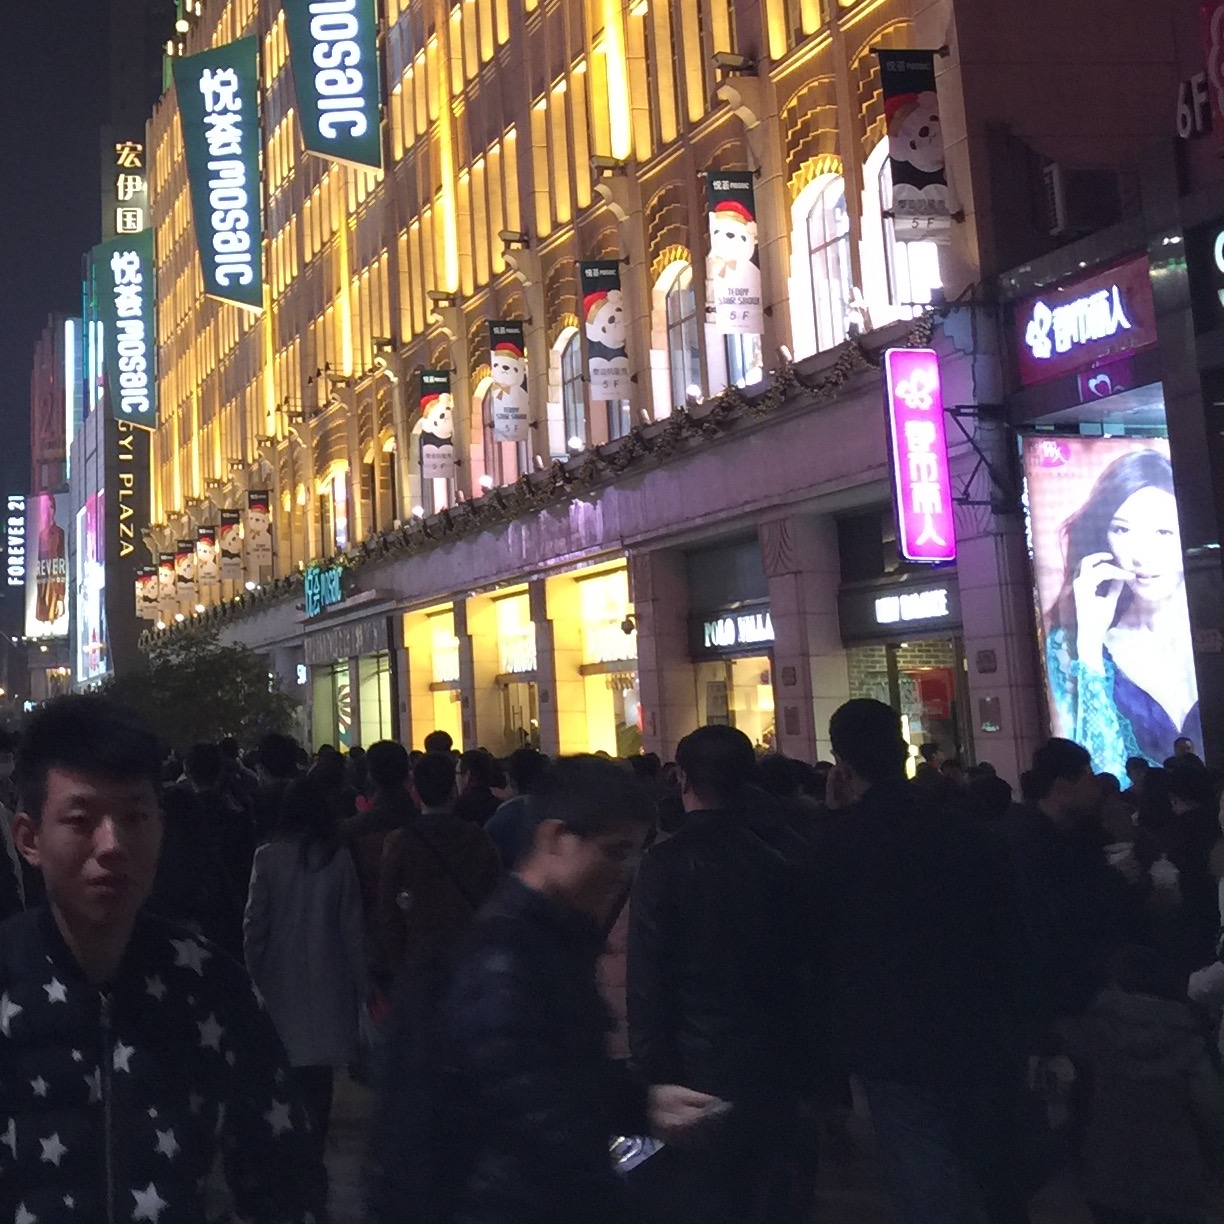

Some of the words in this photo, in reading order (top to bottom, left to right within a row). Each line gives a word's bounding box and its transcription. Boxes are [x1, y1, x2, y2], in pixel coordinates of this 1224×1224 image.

[7, 495, 26, 511] 21
[118, 473, 136, 559] PLAZA
[7, 516, 26, 586] FOREVER
